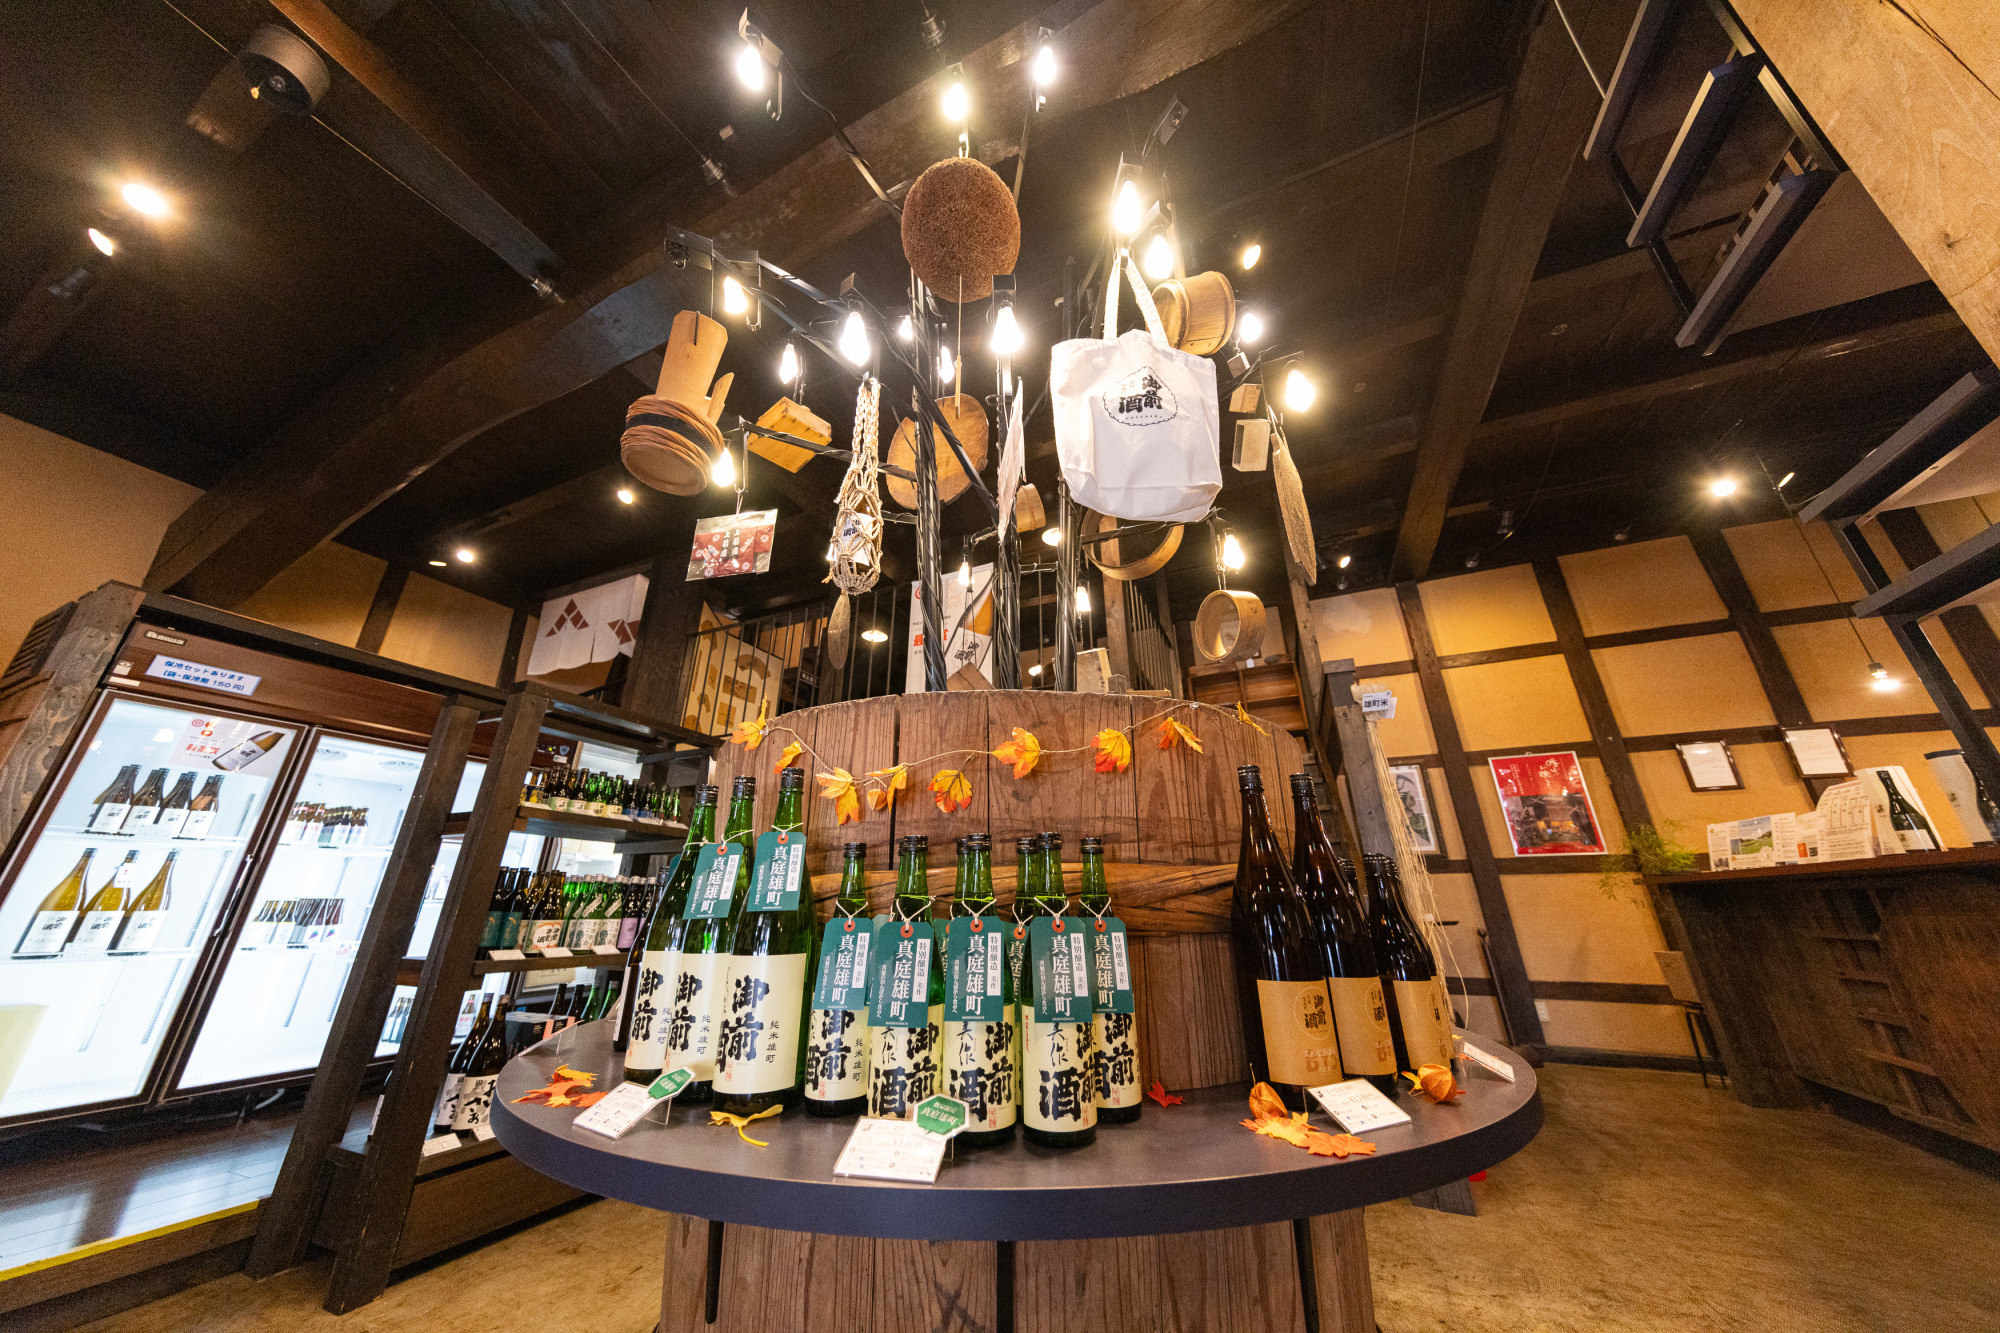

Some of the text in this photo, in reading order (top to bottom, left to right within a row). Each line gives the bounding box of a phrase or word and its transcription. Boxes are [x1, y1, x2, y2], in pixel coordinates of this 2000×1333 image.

[1118, 394, 1142, 414] 酒
[164, 660, 244, 681] 保冷セットあります
[213, 680, 231, 688] 150
[1363, 699, 1388, 708] 雄町米
[701, 857, 726, 914] 真庭雄町
[766, 845, 788, 906] 真庭雄町
[831, 934, 855, 1005] 真庭雄町
[889, 940, 914, 1021] 真庭雄町
[965, 934, 985, 1015] 真庭雄町
[1051, 935, 1072, 1017] 真庭雄町
[1094, 934, 1114, 1008] 真庭雄町
[632, 967, 664, 1041] 御前
[657, 1007, 671, 1044] 純米雄町
[669, 971, 702, 1051] 御前
[728, 975, 769, 1061] 御前
[697, 1014, 711, 1054] 純米雄町
[765, 1020, 779, 1063] 純米雄町
[819, 1010, 855, 1081] 御前
[852, 1037, 863, 1081] 純米雄町
[905, 1022, 939, 1104] 御前
[984, 1022, 1013, 1105] 御前
[1104, 1013, 1135, 1086] 御前
[872, 1066, 907, 1117] 酒
[921, 1106, 959, 1125] 真庭雄町
[949, 1067, 987, 1122] 酒
[1039, 1066, 1081, 1122] 酒
